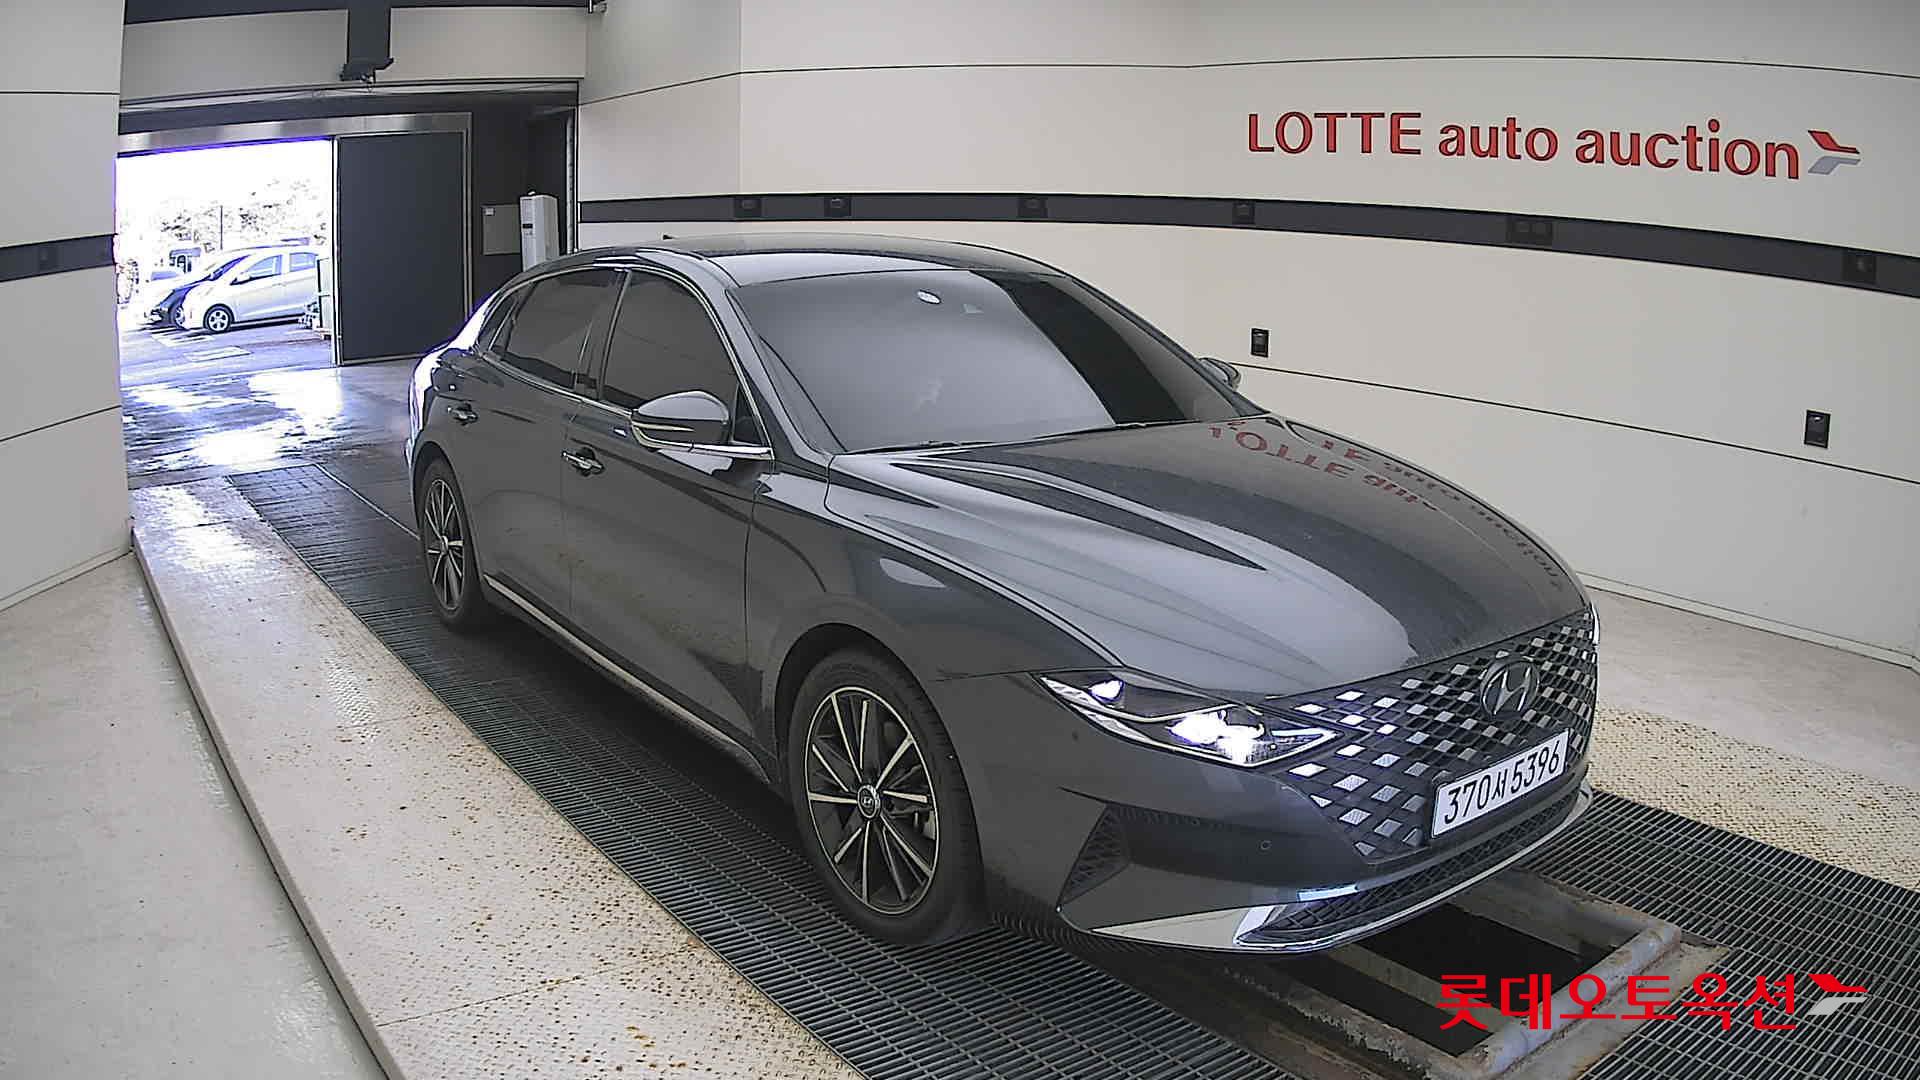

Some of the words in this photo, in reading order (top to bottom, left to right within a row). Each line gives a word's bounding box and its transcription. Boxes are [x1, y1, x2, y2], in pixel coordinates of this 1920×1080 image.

[1248, 112, 1422, 155] LOTTE
[1438, 118, 1559, 162] auto
[1575, 119, 1799, 179] auction
[1444, 740, 1560, 825] 370서5396
